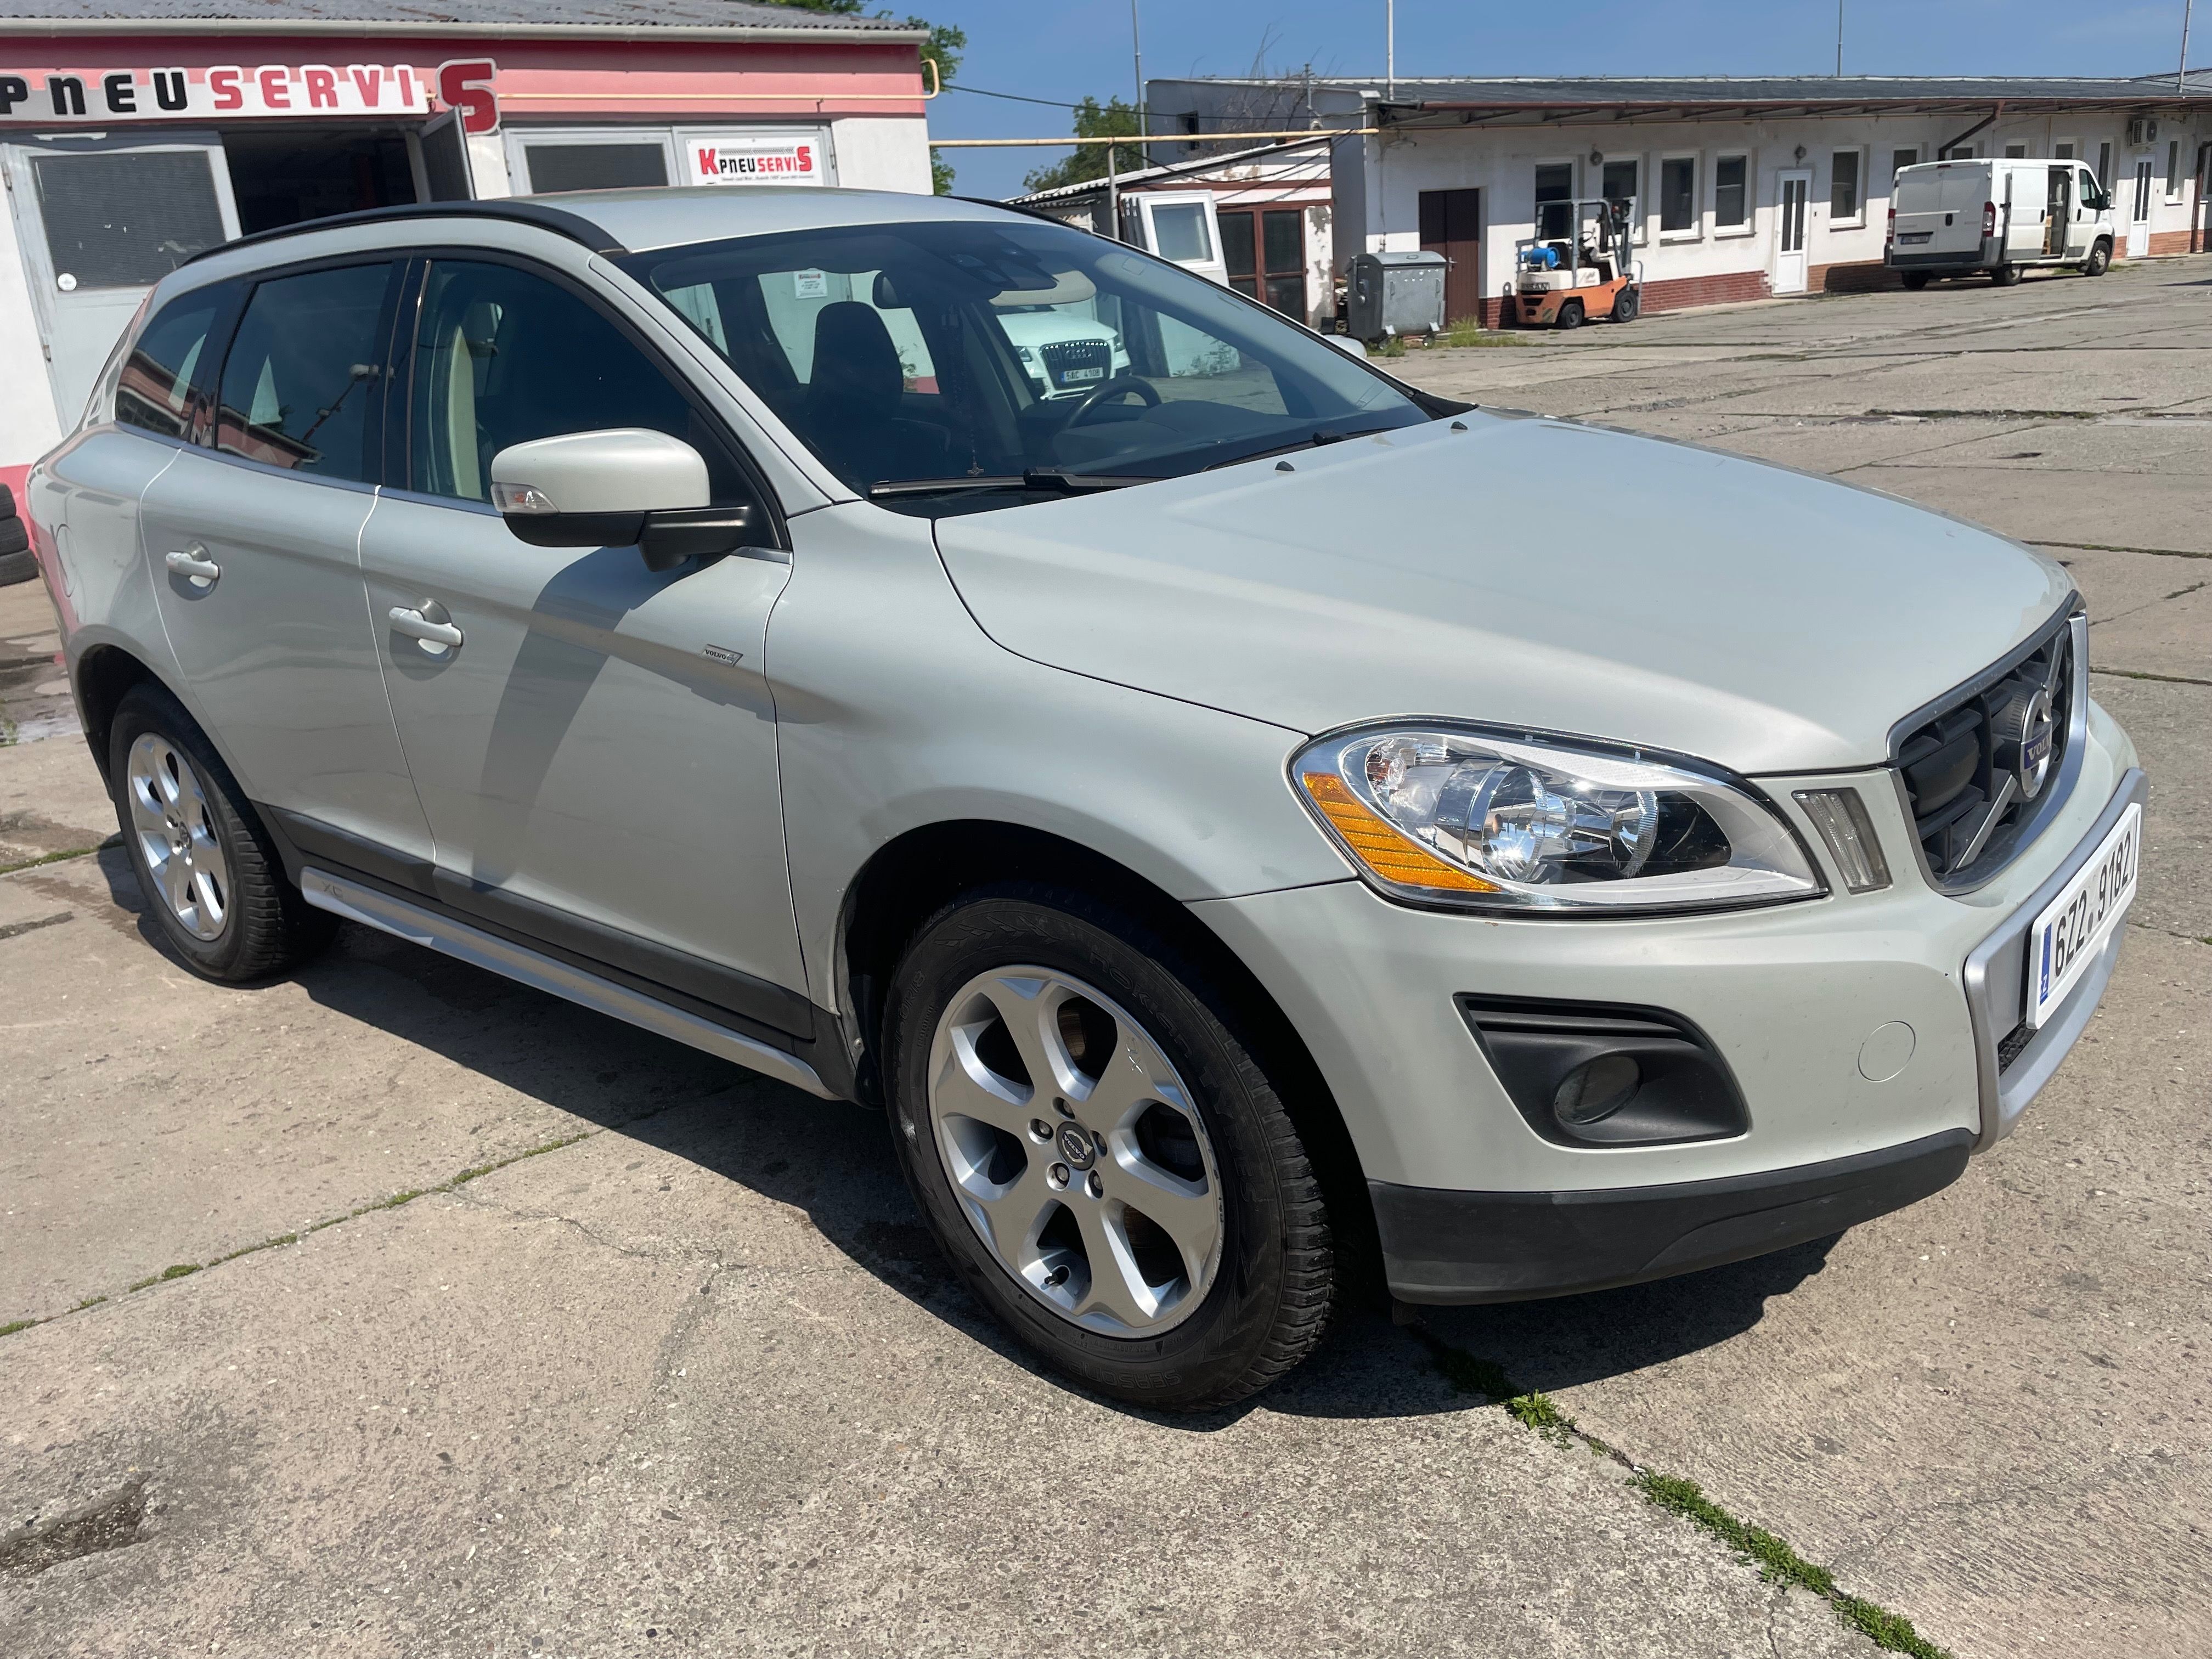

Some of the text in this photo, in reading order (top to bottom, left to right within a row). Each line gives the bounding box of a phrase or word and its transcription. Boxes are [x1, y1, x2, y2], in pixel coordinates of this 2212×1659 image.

[705, 649, 726, 659] VOLVO
[2055, 830, 2131, 977] 6Z2 9182
[1063, 1133, 1086, 1160] VOLVO
